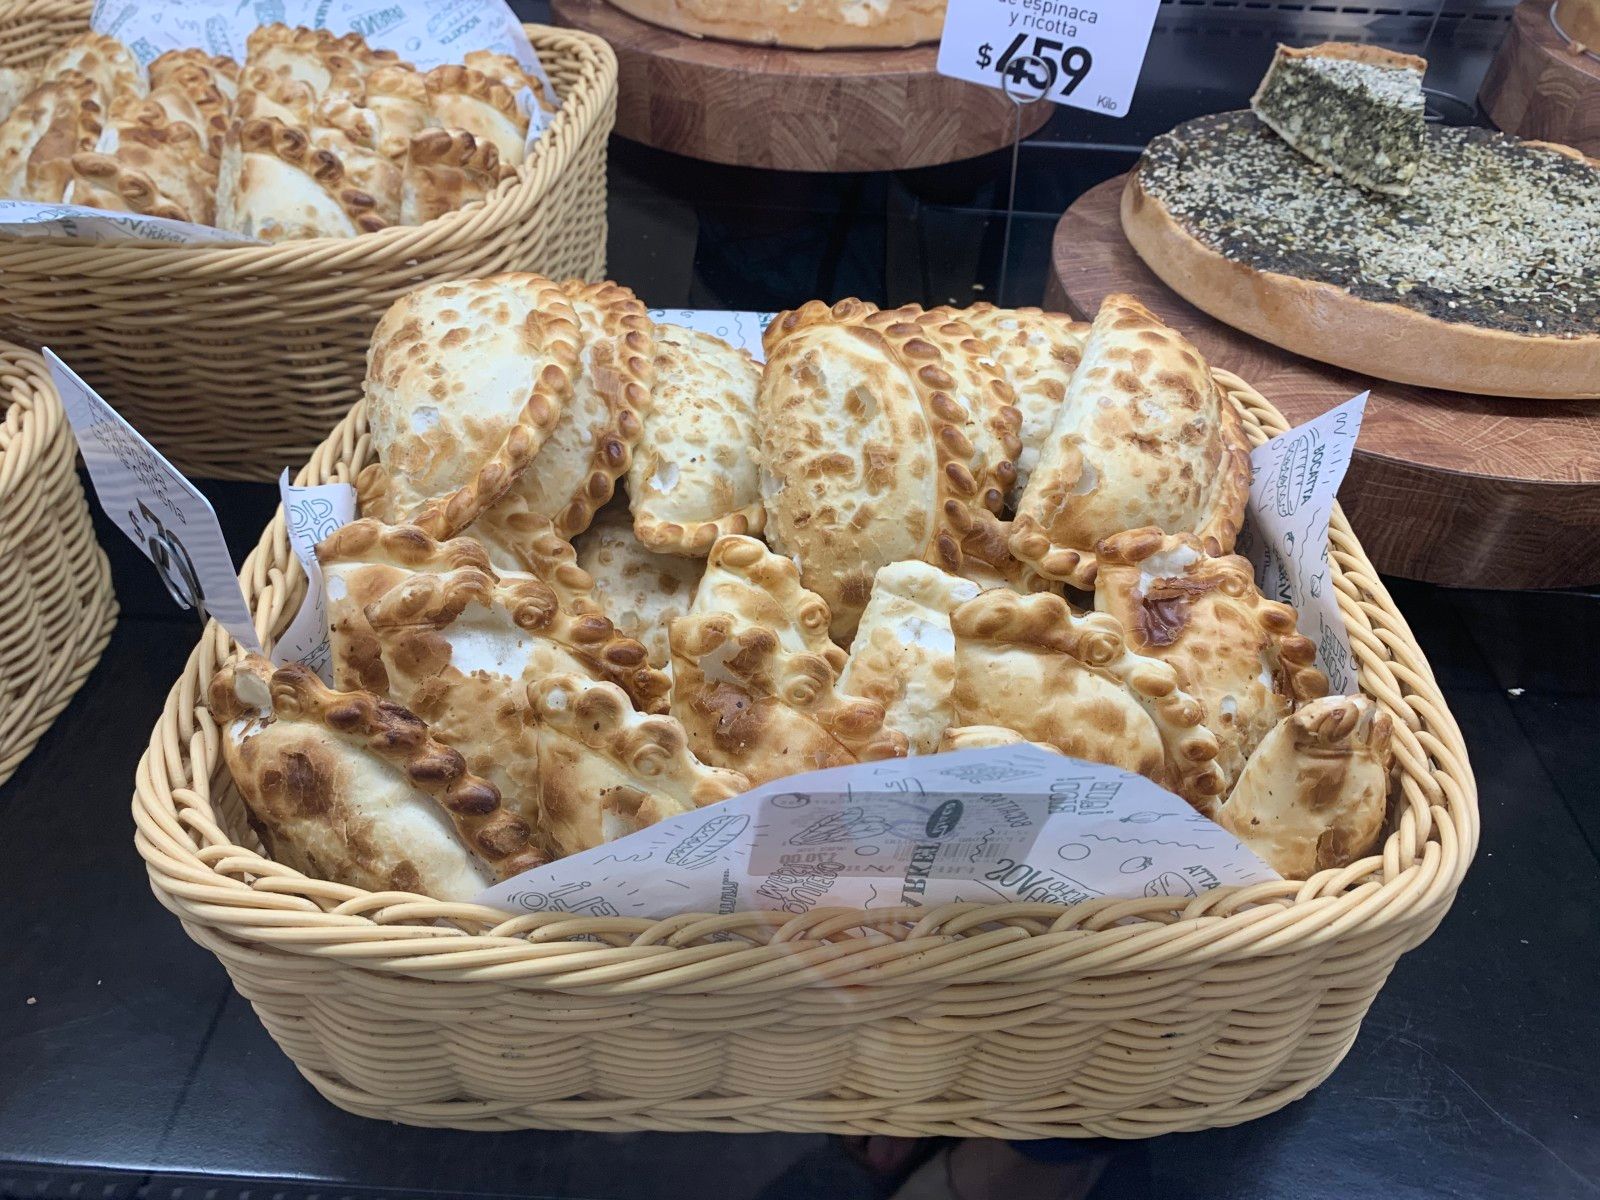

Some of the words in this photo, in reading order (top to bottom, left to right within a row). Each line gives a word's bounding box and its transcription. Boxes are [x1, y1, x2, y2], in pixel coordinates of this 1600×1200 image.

[1008, 11, 1019, 27] y
[1022, 13, 1078, 38] ricotta
[1023, 0, 1098, 24] espinaca
[1096, 95, 1118, 110] Kilo
[1301, 443, 1326, 506] BOCATTA
